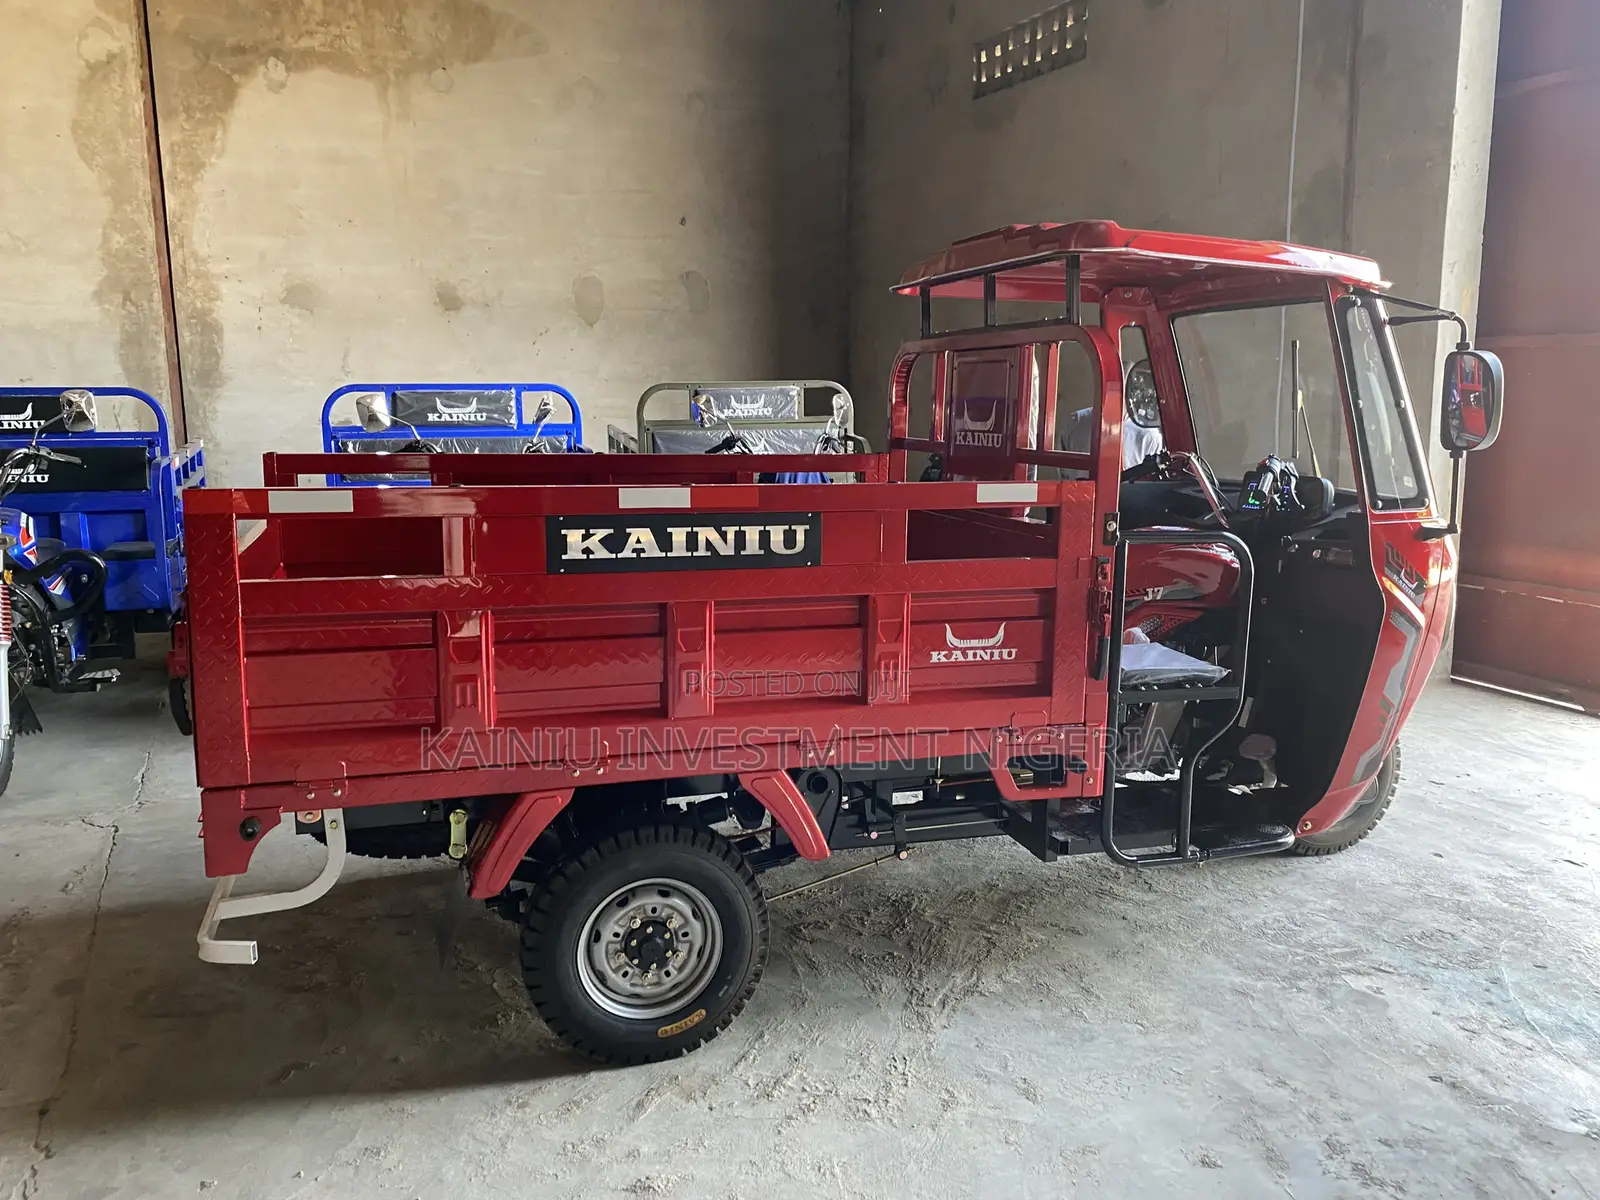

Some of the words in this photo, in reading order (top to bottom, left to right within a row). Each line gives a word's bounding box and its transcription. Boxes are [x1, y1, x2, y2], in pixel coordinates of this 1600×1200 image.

[427, 413, 487, 422] KAINIU
[723, 408, 773, 417] KAINIU
[0, 420, 46, 430] INIU
[955, 431, 1003, 448] KAINIU
[561, 524, 810, 560] KAINIU
[929, 648, 1018, 664] KAINIU
